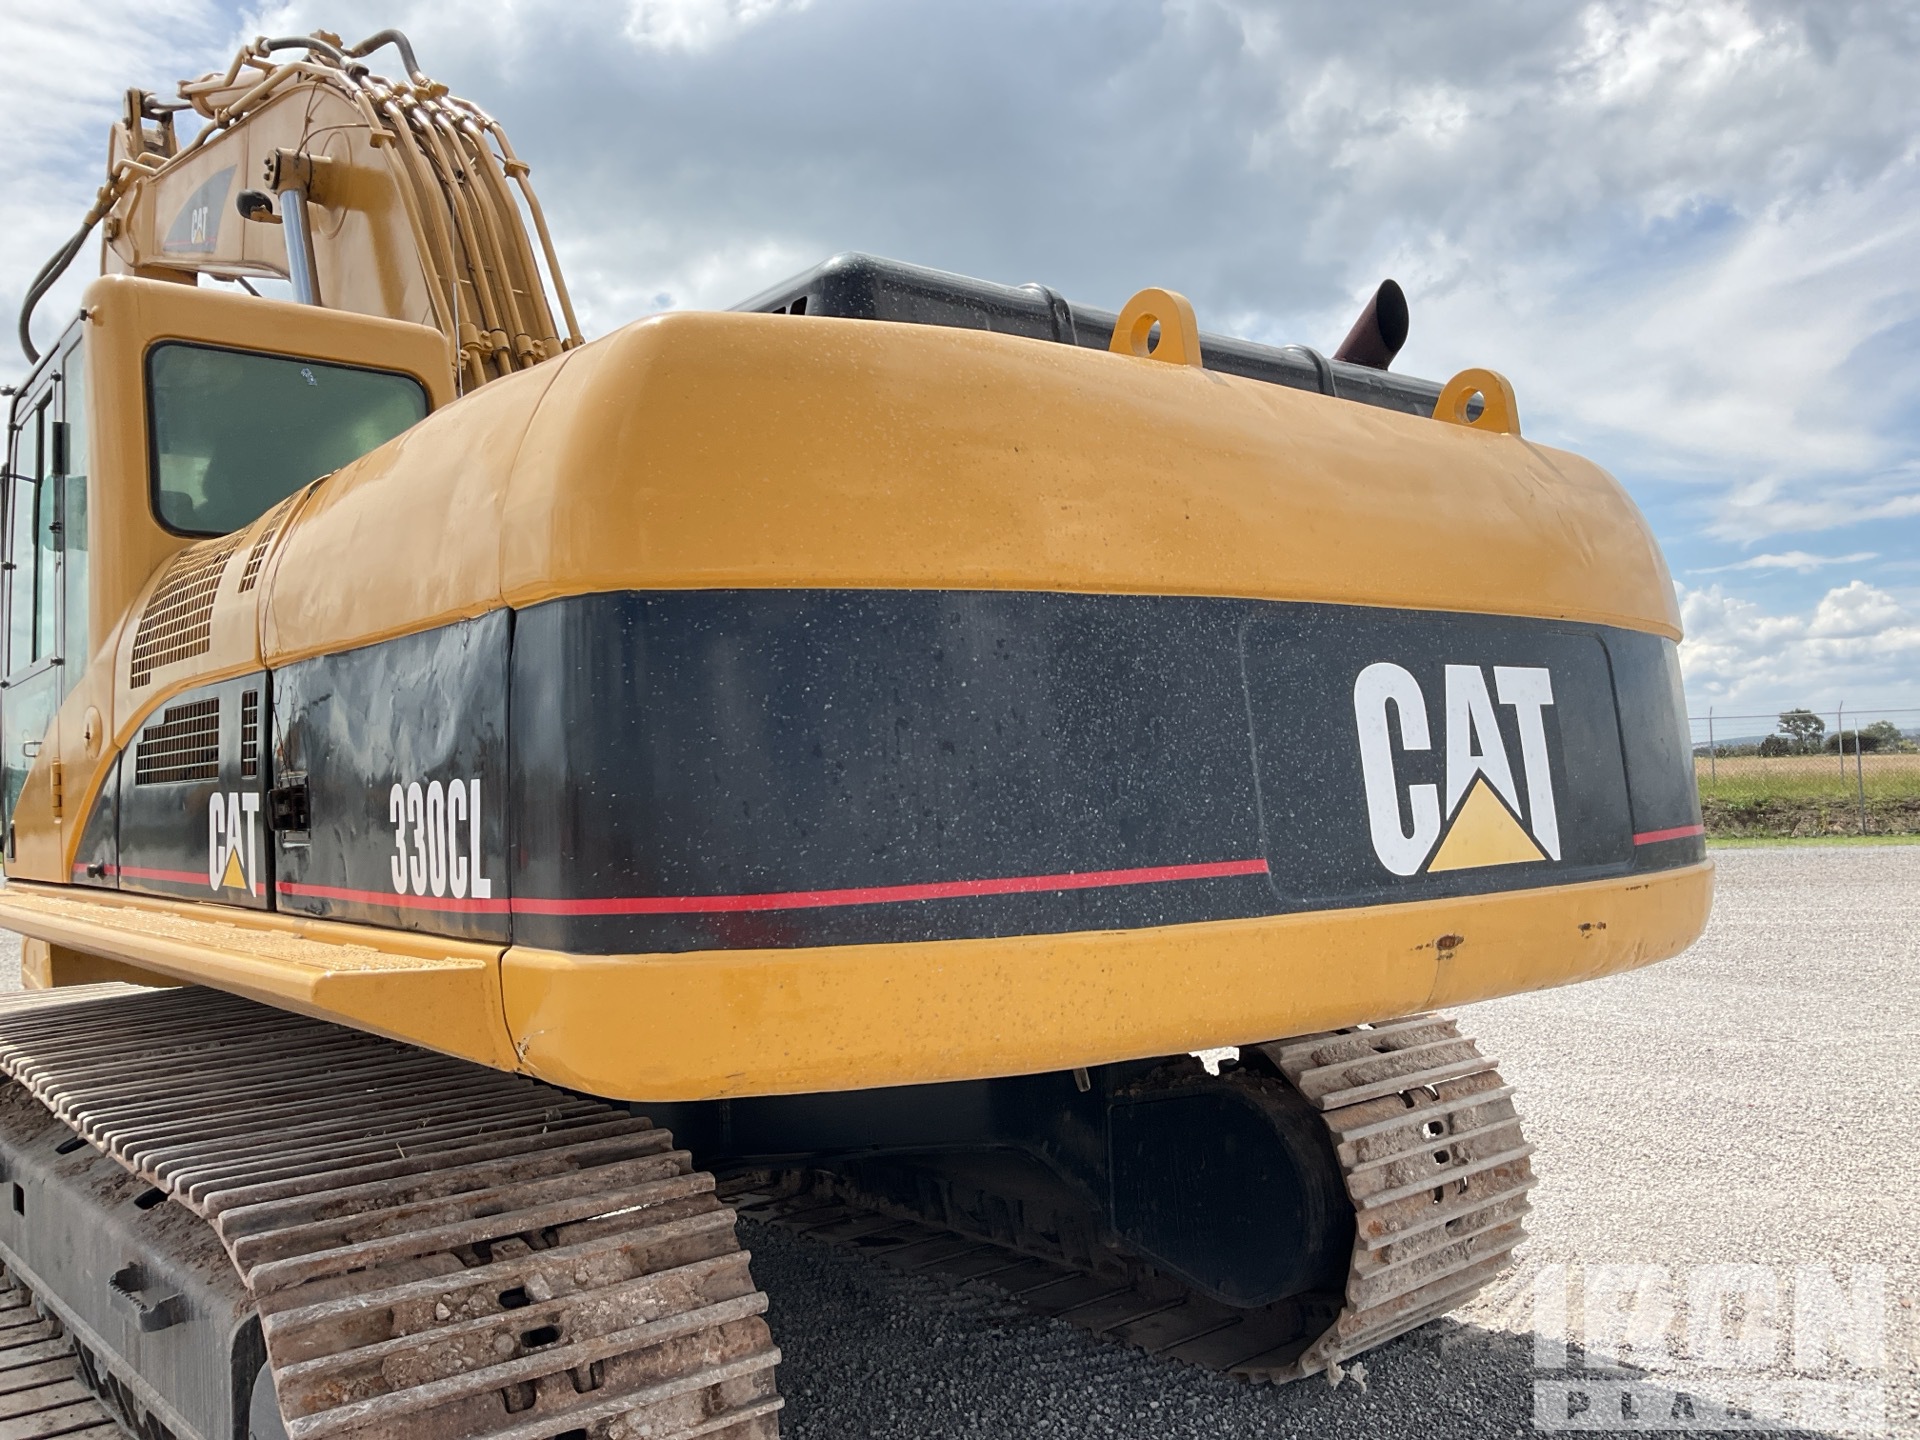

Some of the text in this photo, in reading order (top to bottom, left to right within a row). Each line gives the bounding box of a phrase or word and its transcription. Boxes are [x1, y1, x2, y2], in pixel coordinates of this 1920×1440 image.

[191, 207, 208, 244] CAT
[1354, 662, 1561, 876] CAT
[209, 791, 259, 897] CAT
[390, 778, 491, 899] 330CL
